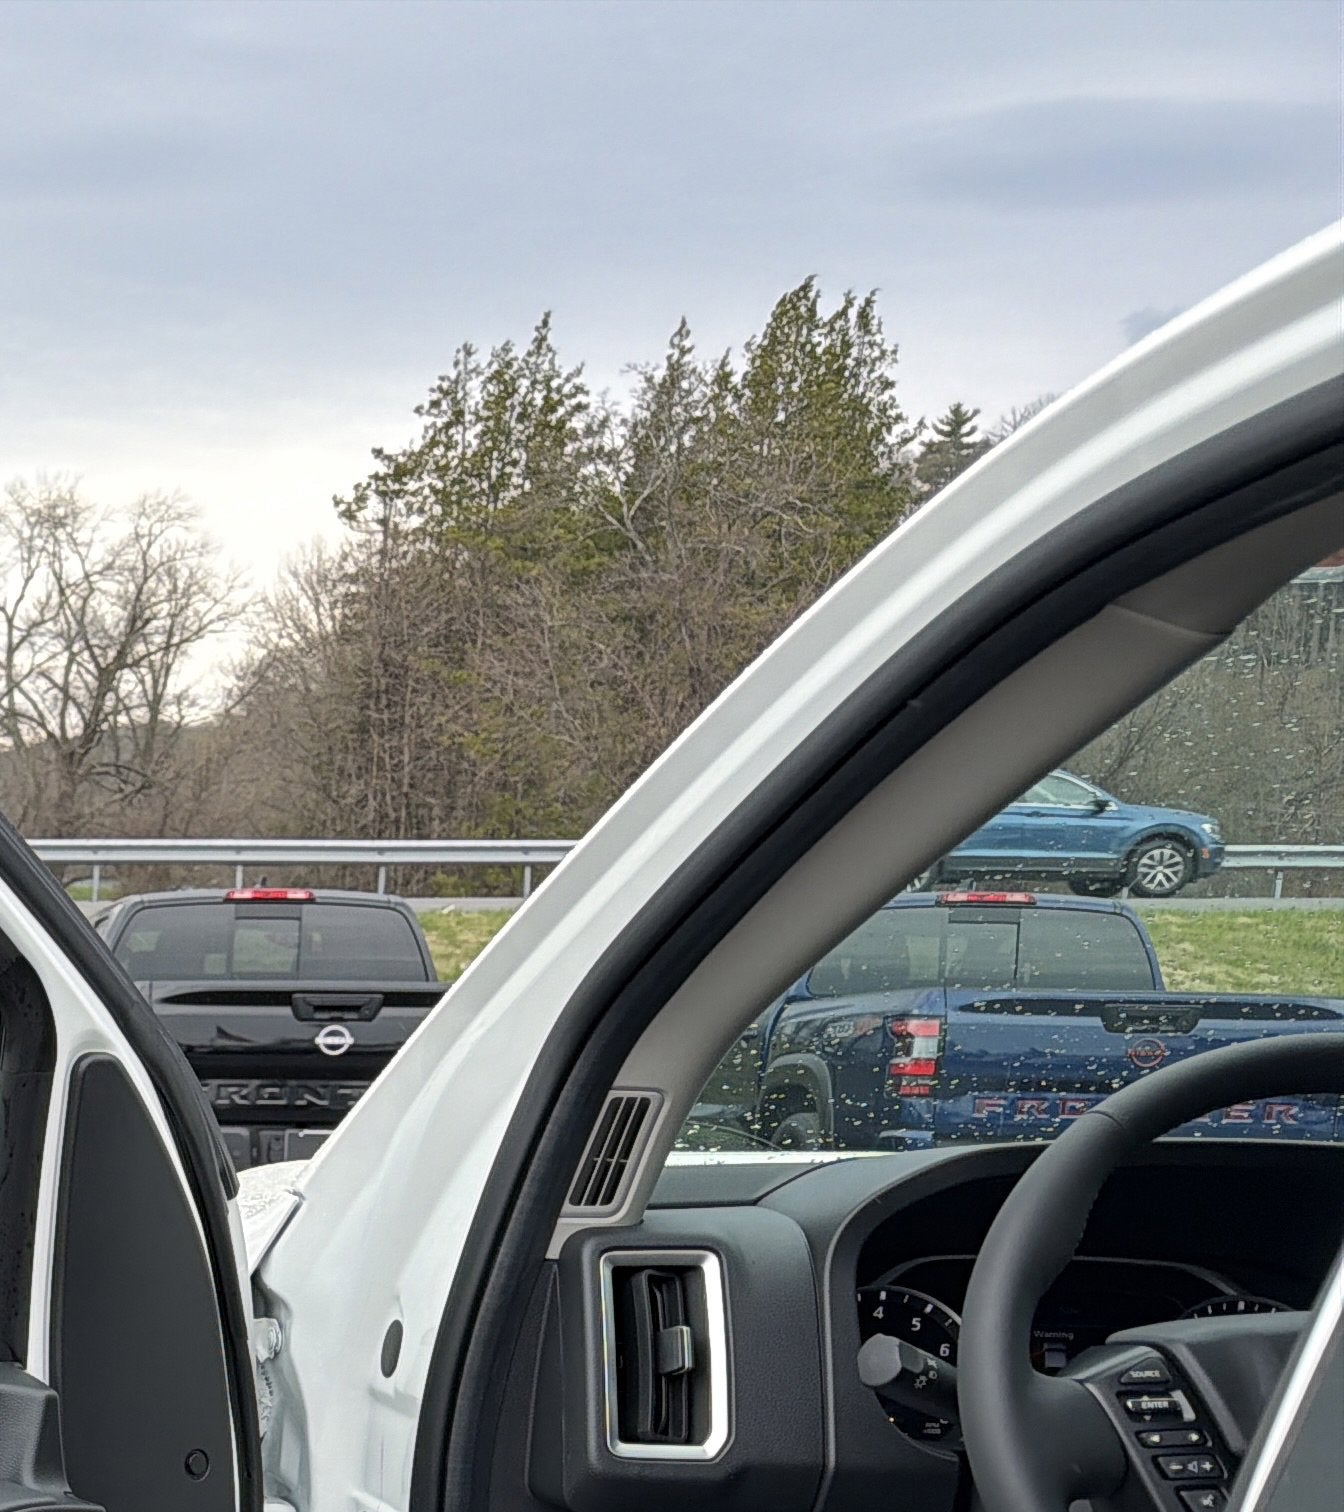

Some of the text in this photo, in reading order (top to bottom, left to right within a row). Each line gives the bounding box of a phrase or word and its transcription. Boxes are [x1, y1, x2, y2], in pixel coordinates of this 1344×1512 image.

[872, 1306, 884, 1319] 4
[911, 1317, 922, 1331] 5
[1033, 1330, 1075, 1341] Warning
[939, 1343, 950, 1357] 6
[1129, 1370, 1161, 1378] SOURCE
[1141, 1401, 1169, 1409] ENTER
